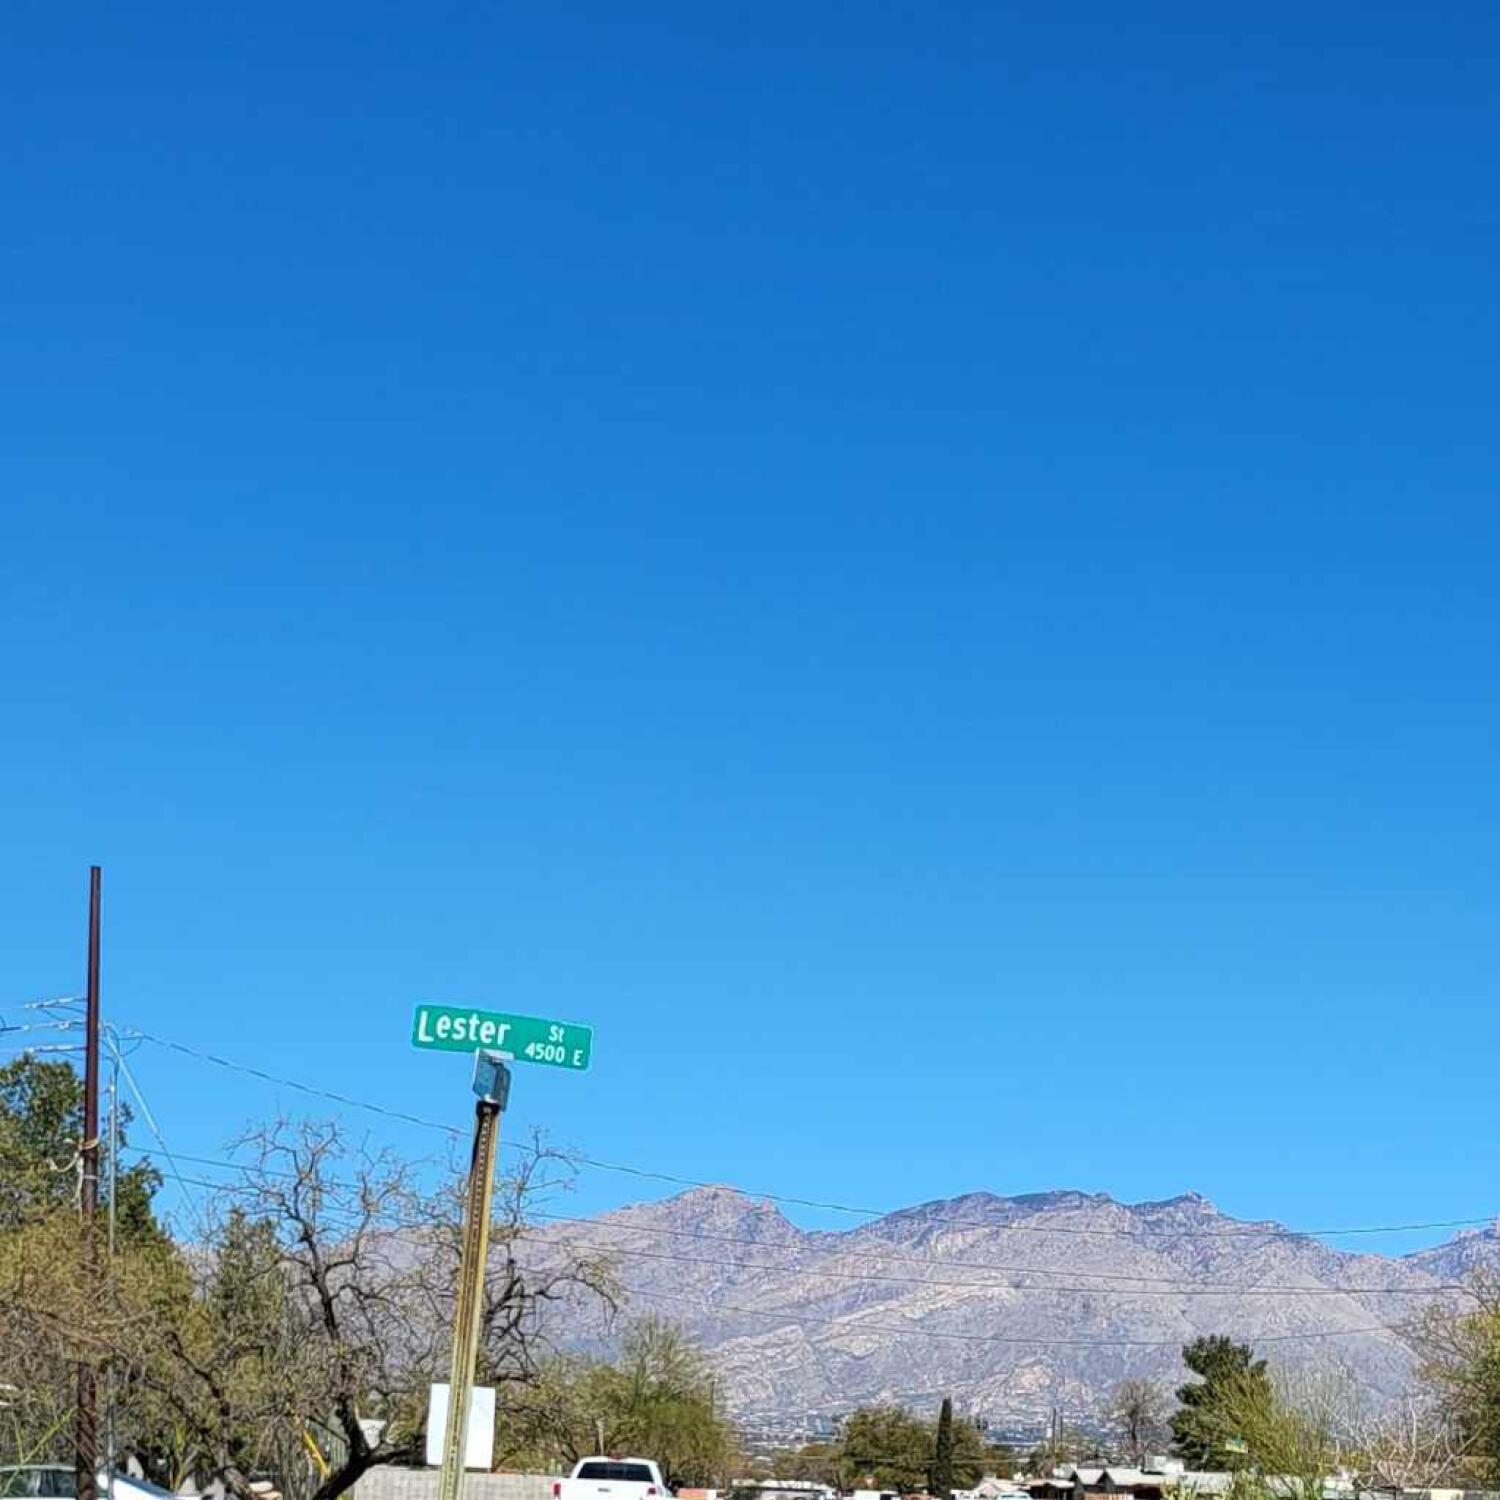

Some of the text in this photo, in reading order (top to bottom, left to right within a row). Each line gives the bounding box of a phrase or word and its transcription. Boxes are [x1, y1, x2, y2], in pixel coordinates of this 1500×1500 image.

[418, 1011, 565, 1045] Lester St
[524, 1042, 584, 1066] 4500 E
